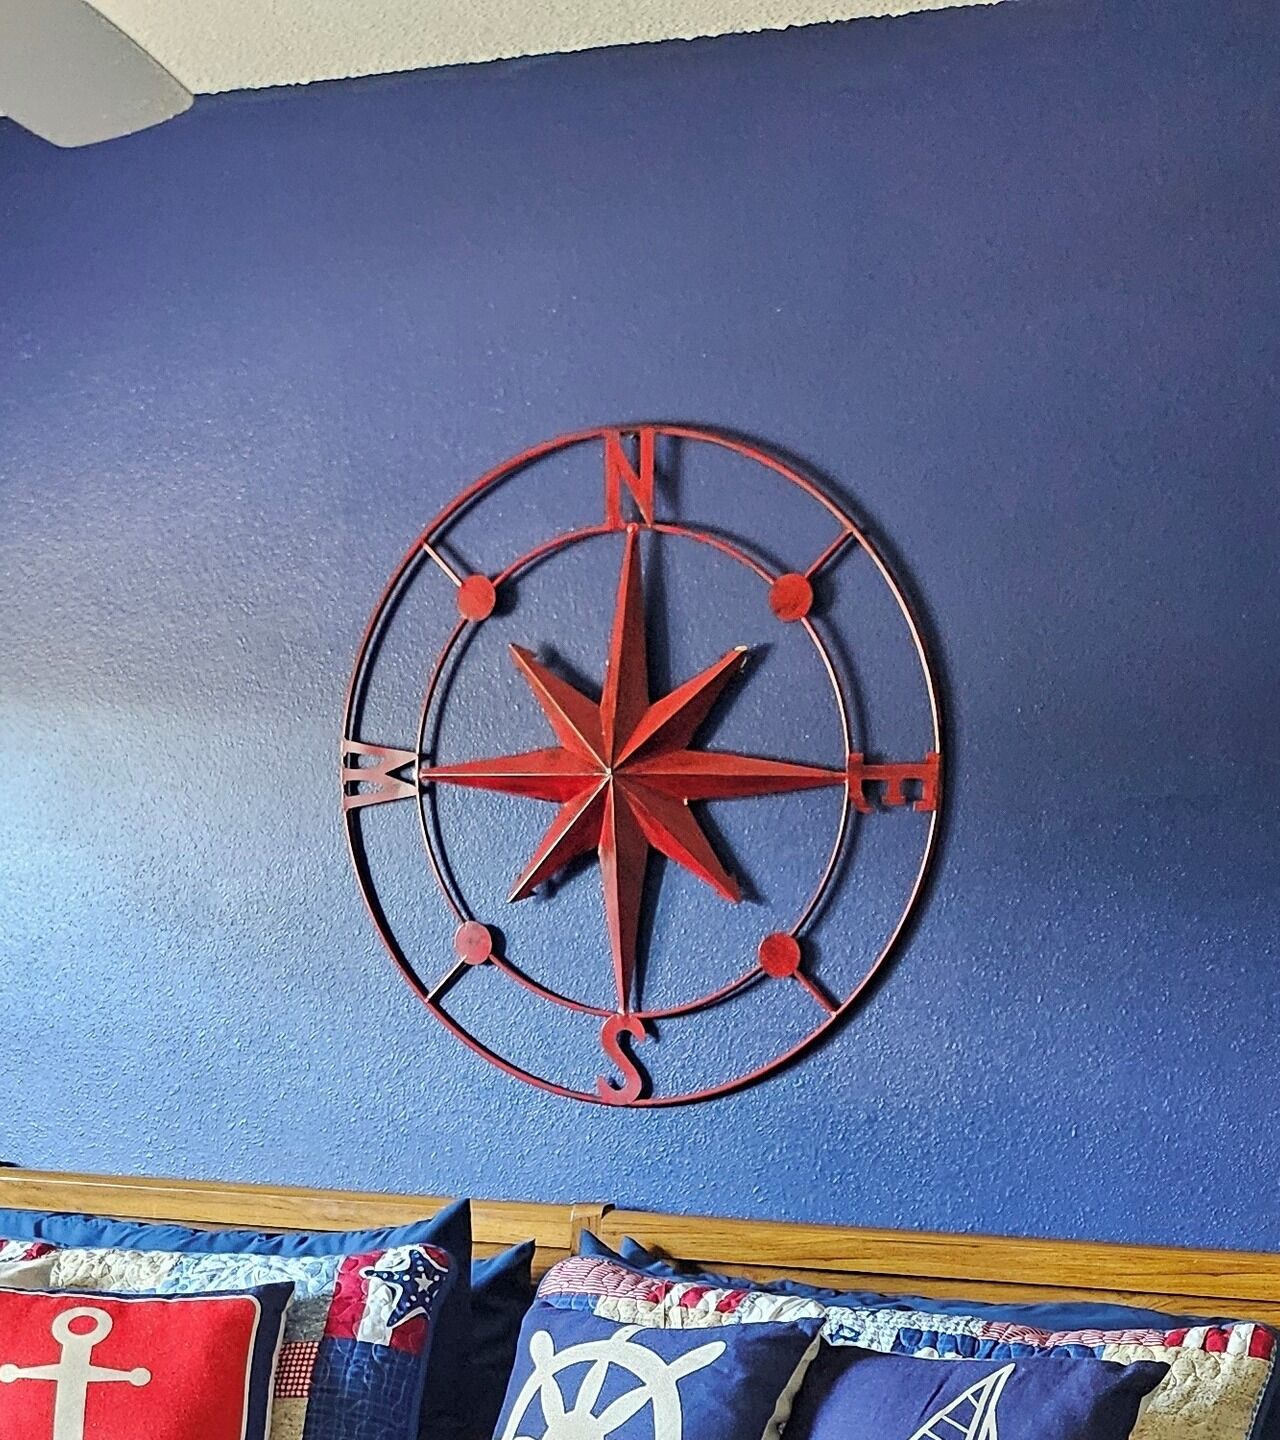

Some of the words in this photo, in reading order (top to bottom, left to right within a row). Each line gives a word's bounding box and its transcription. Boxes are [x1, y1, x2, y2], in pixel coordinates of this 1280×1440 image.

[604, 429, 655, 527] N
[343, 738, 421, 812] W
[847, 751, 940, 813] E
[596, 1017, 653, 1106] S
